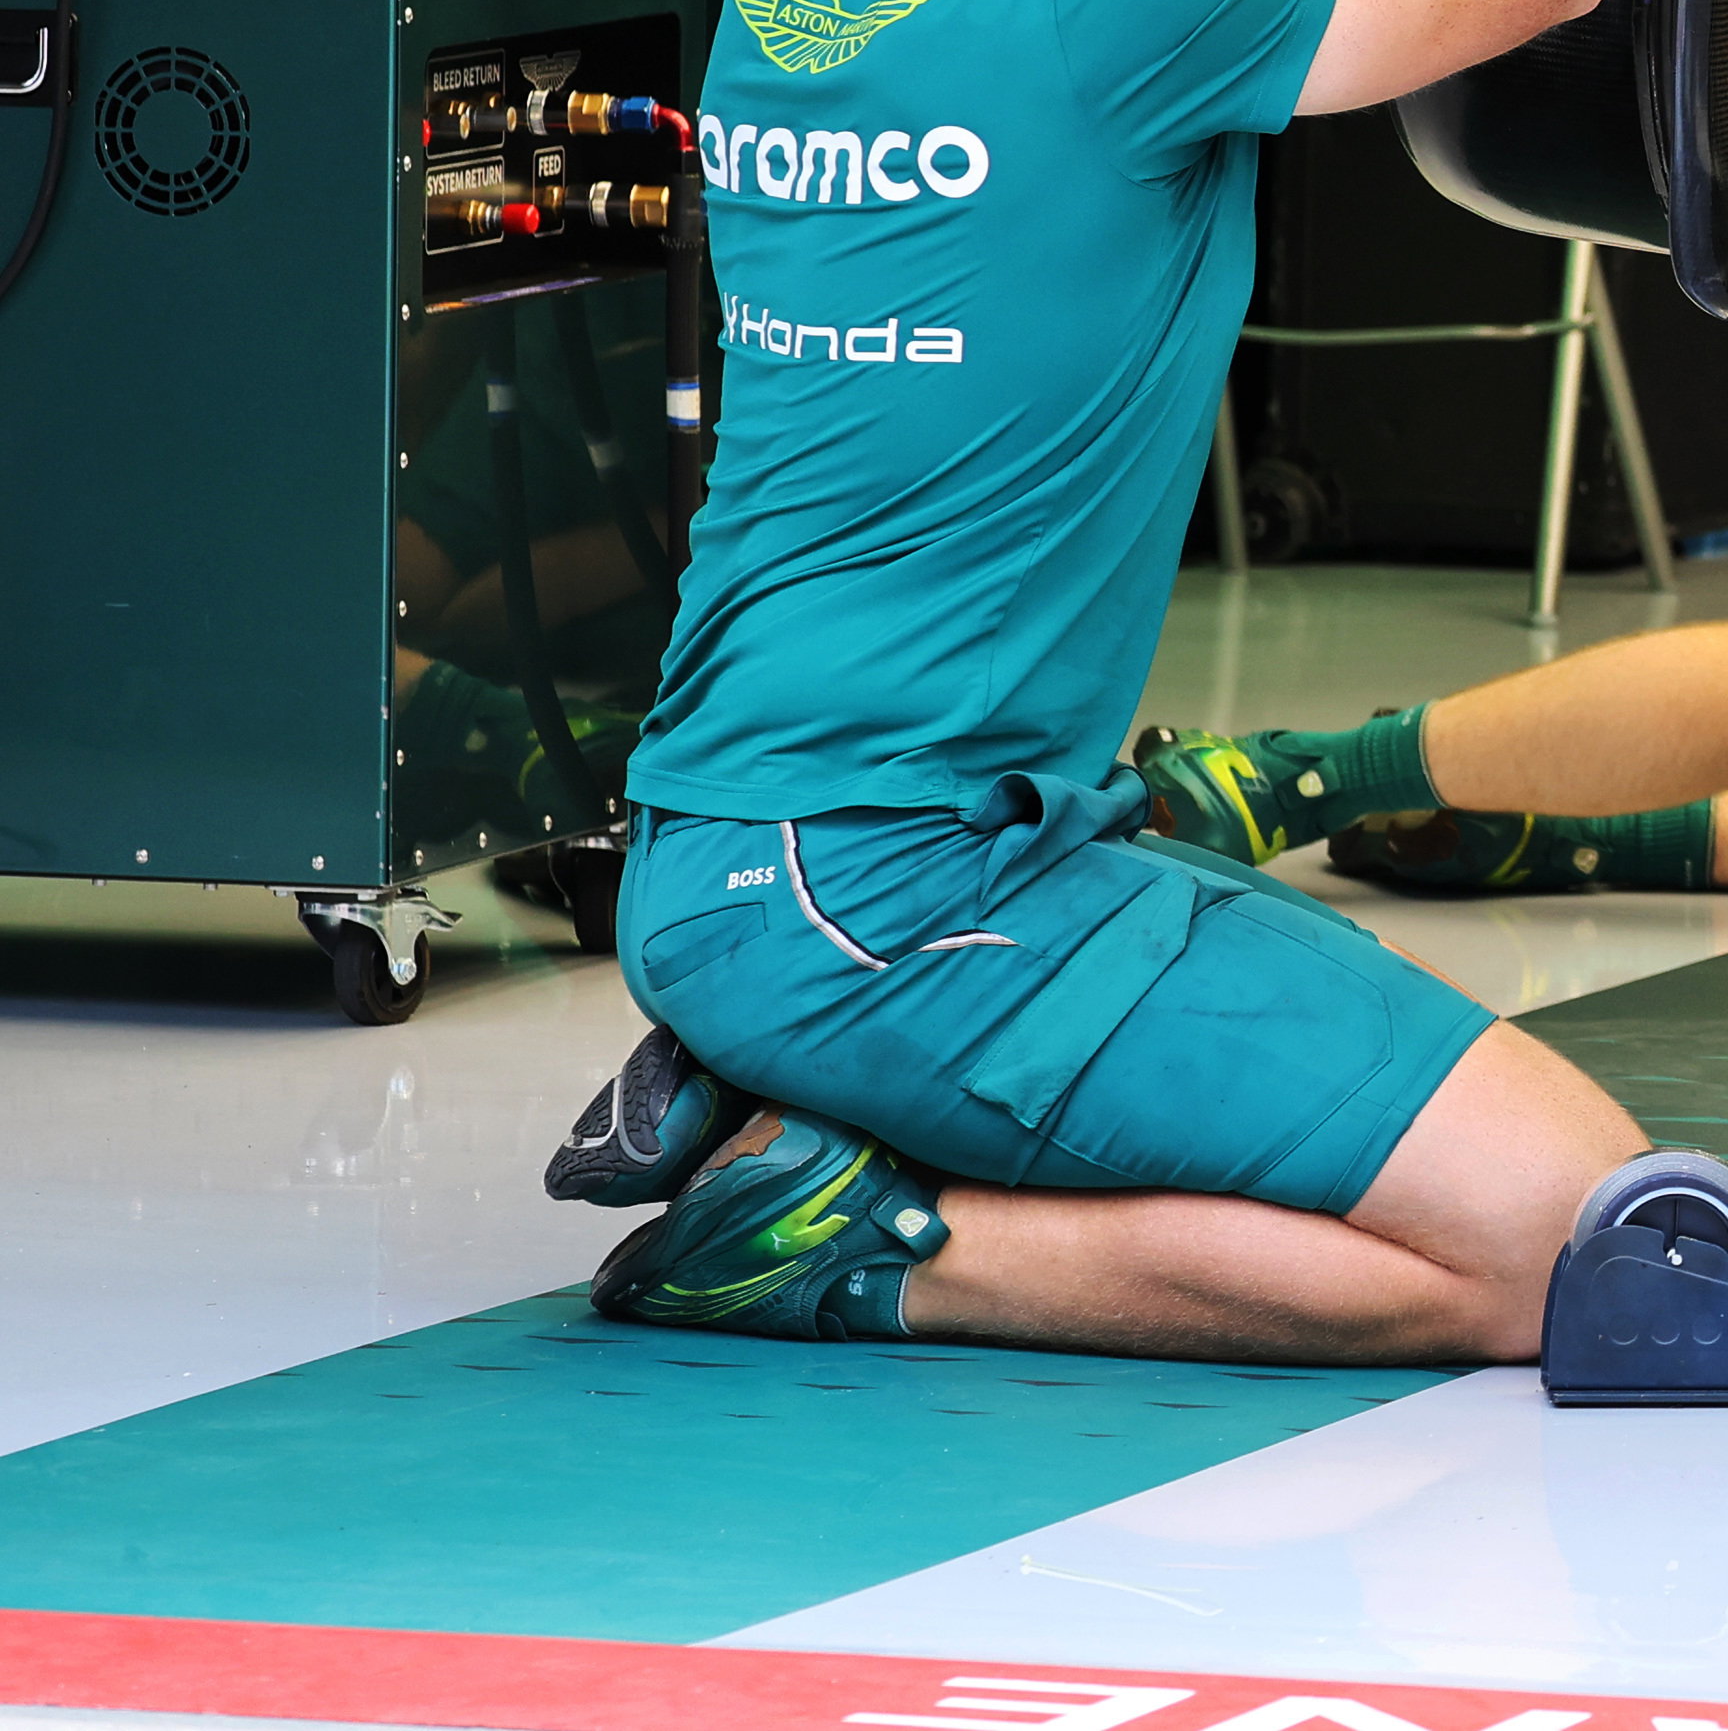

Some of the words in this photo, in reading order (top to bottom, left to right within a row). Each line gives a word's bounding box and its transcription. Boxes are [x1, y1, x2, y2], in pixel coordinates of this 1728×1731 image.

[776, 3, 840, 38] ASTON
[433, 70, 462, 92] BLEED
[463, 64, 501, 88] RETURN
[538, 155, 562, 178] FEED
[698, 114, 990, 205] aramco
[427, 172, 465, 197] SYSTEM
[465, 165, 503, 190] RETURN
[741, 303, 964, 363] Honda
[726, 865, 777, 890] BOSS
